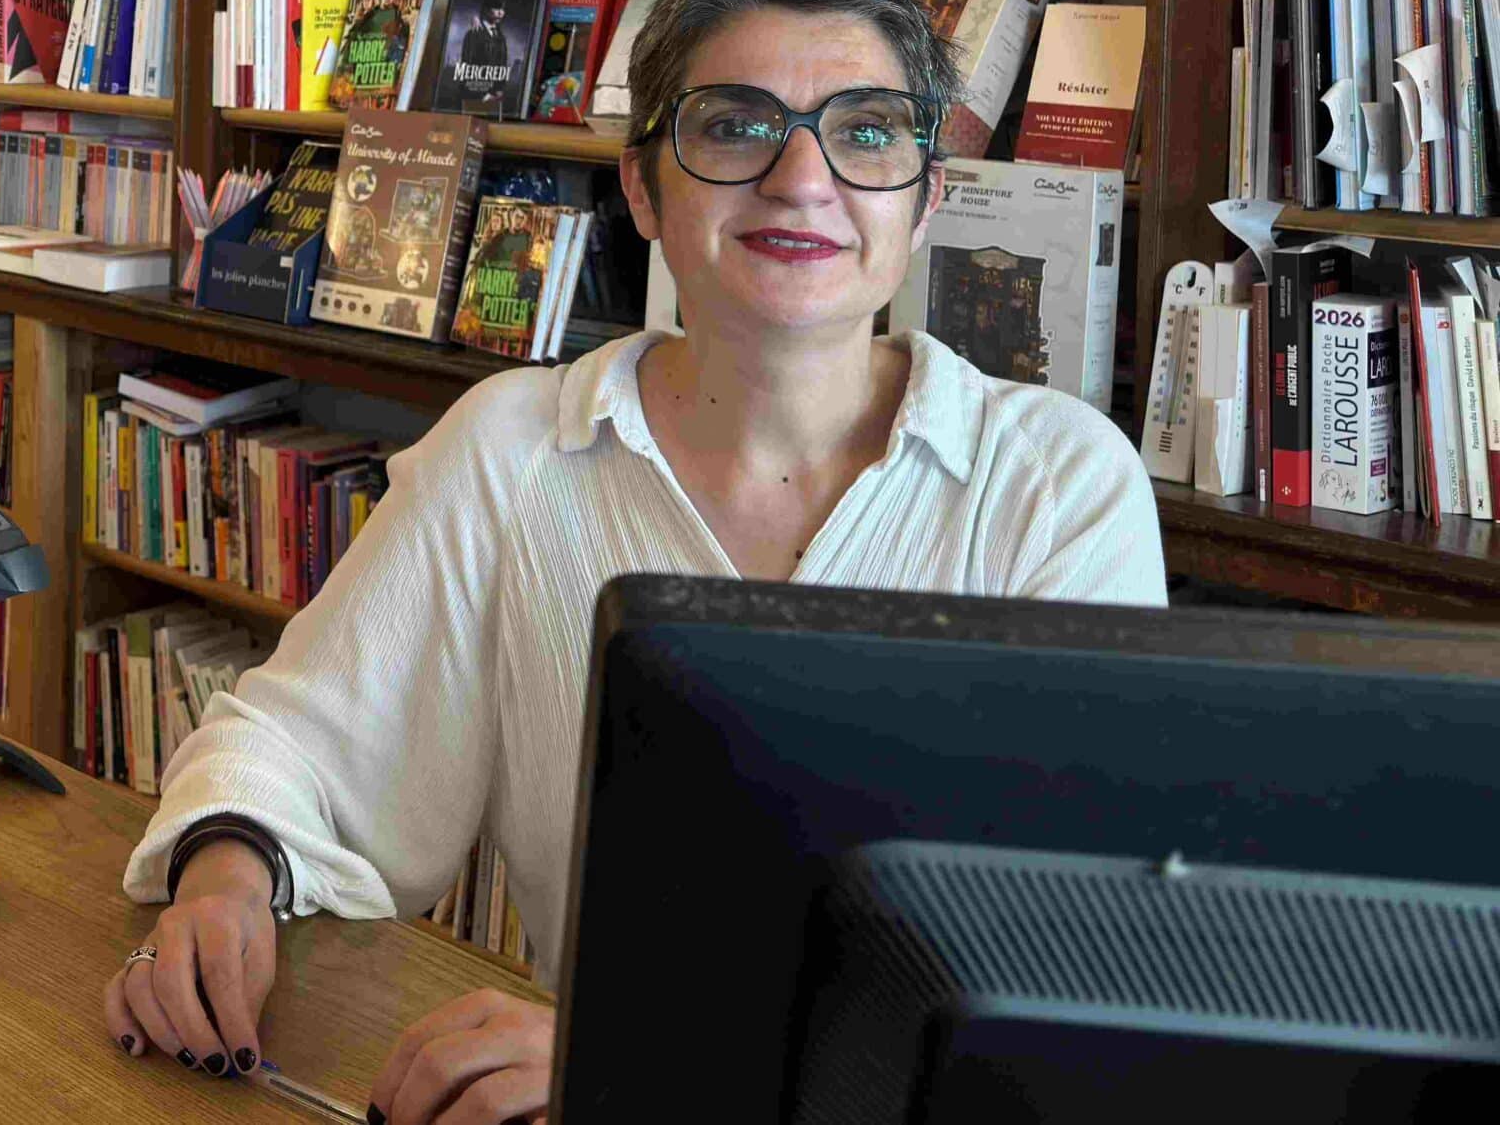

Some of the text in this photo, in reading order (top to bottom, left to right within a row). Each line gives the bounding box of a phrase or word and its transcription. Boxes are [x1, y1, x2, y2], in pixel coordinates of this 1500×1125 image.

[350, 39, 385, 63] HARRY
[353, 62, 396, 85] POTTER
[454, 61, 511, 81] MERCREDI
[1058, 82, 1109, 95] Résister
[1036, 114, 1113, 128] NOUVELLE ÉDITION
[347, 143, 457, 167] University of Miracle
[960, 197, 991, 207] HOUSE
[961, 186, 1014, 199] MINIATURE
[266, 190, 327, 230] PAS UNE
[212, 266, 287, 290] les jolies planches
[477, 266, 518, 294] HARRY
[482, 295, 530, 325] POTTER
[1314, 308, 1365, 328] 2026
[1465, 336, 1473, 362] Breton
[1466, 371, 1474, 388] David
[1321, 334, 1332, 463] Dictionnaire Poche
[1334, 336, 1359, 468] LAROUSSE
[1469, 389, 1478, 408] risque
